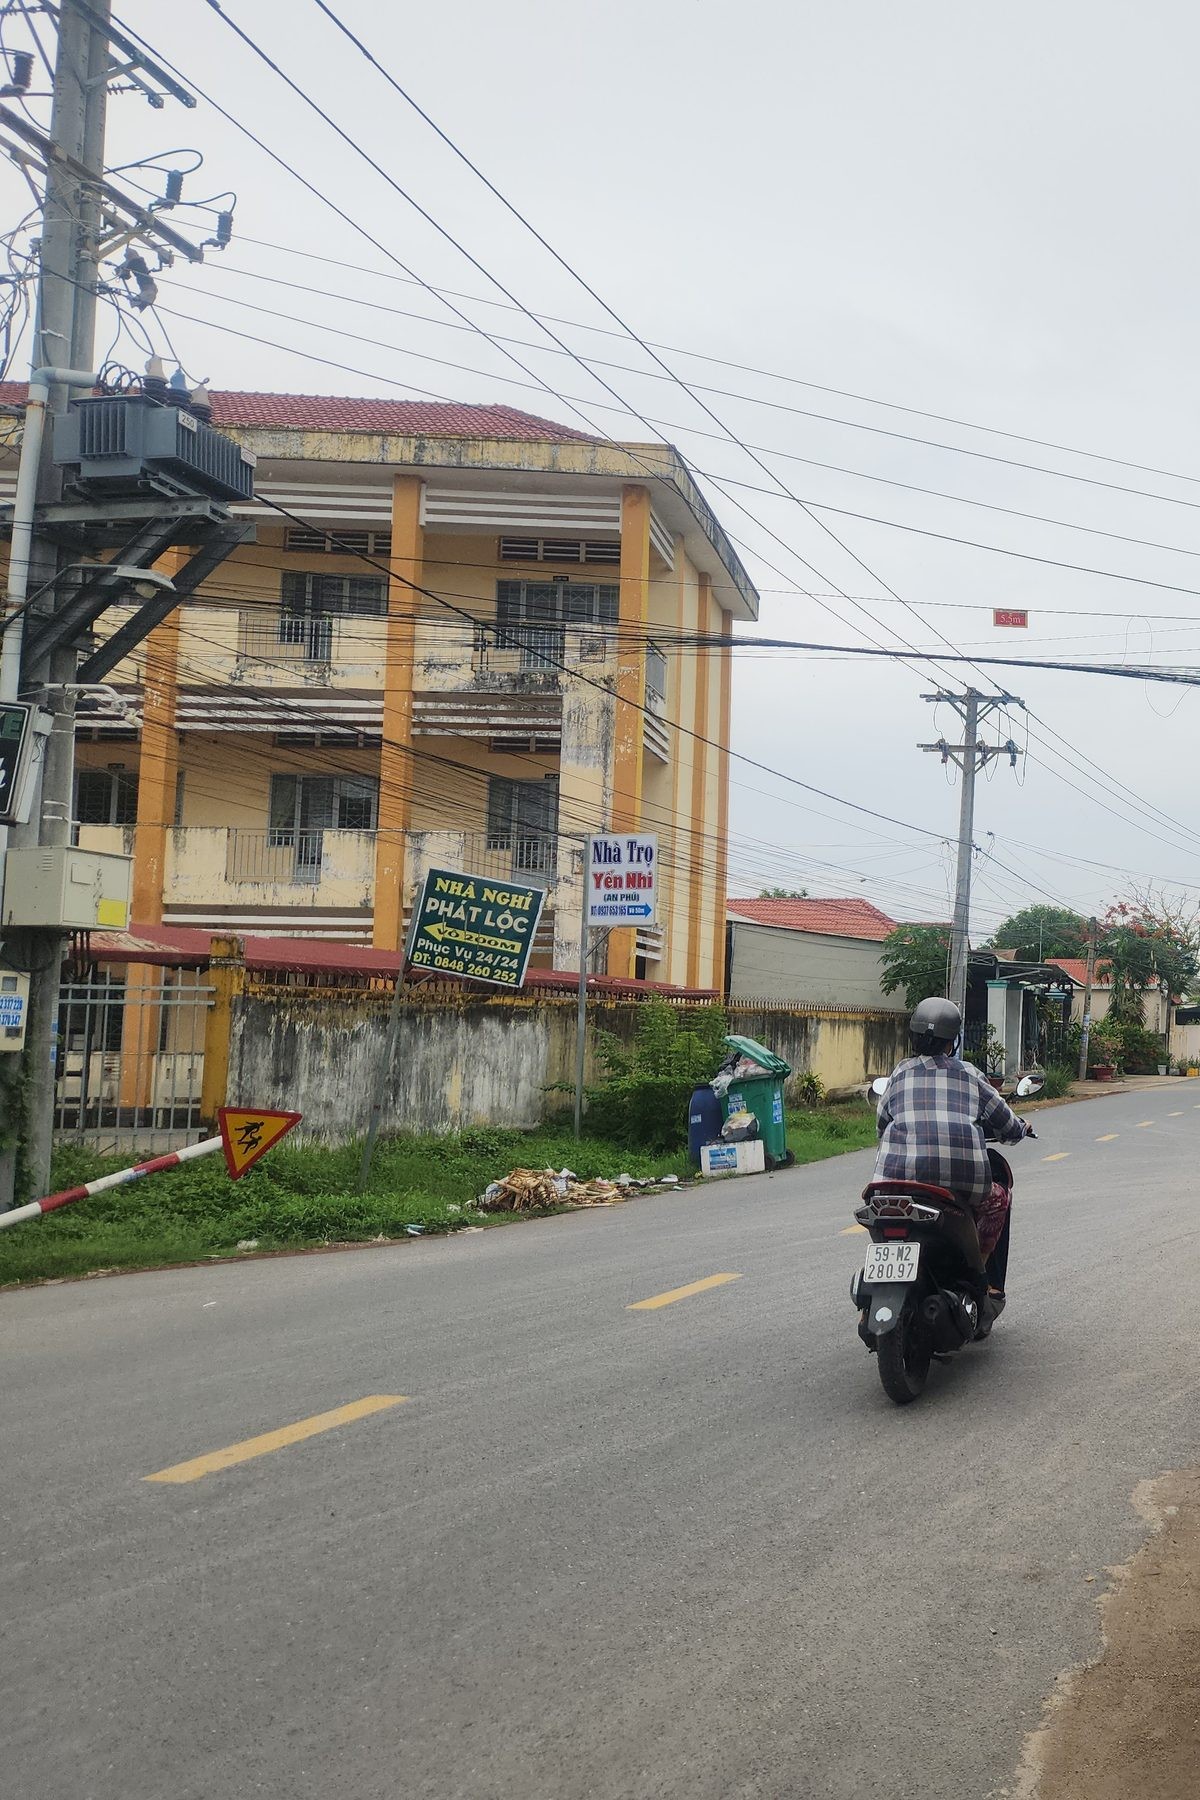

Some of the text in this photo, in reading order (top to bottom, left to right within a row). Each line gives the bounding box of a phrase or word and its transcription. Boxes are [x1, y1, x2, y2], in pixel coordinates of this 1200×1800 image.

[592, 839, 653, 867] Nhà Trọ
[435, 877, 533, 911] NHÀ NGHỈ
[592, 869, 653, 890] Yến Nhi
[425, 897, 529, 934] PHÁT LỘC
[437, 927, 516, 950] VÔ 200M
[413, 951, 517, 983] ĐT: 0848 260 252
[417, 938, 519, 969] Phục Vụ 24/24
[867, 1263, 914, 1279] 280.97
